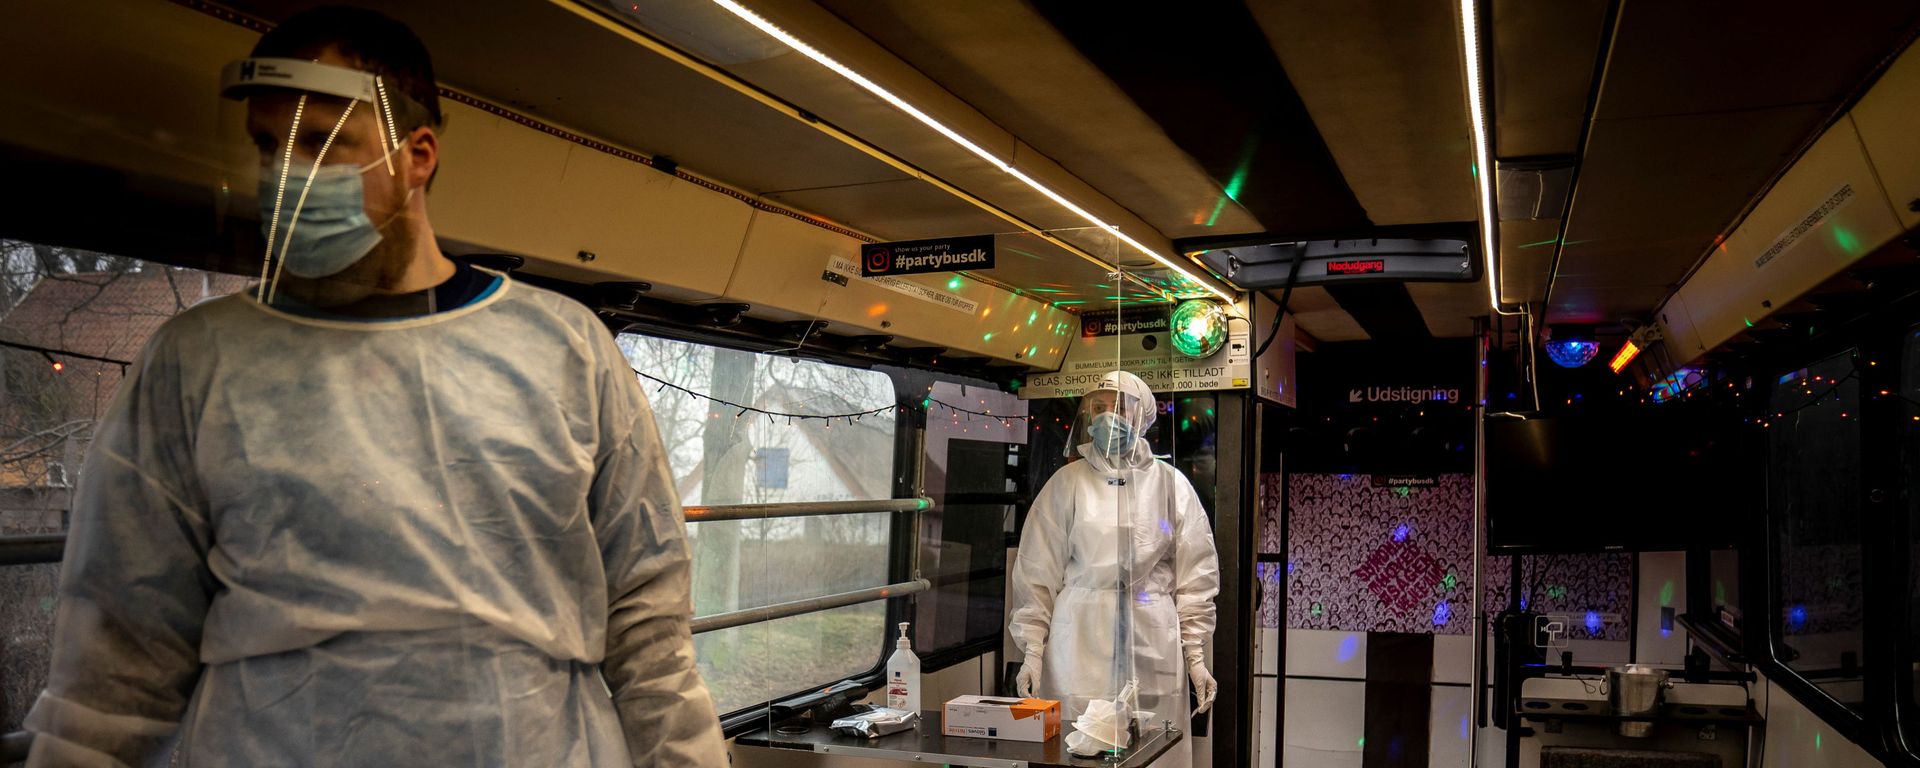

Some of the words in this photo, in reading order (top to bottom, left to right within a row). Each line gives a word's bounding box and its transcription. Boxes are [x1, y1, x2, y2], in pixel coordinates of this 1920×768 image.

[895, 248, 986, 271] #partybusdk
[1156, 369, 1180, 379] IKKE
[1182, 367, 1225, 378] TILLADT
[1367, 385, 1459, 404] Udstigning
[1388, 477, 1434, 486] #partybusdk
